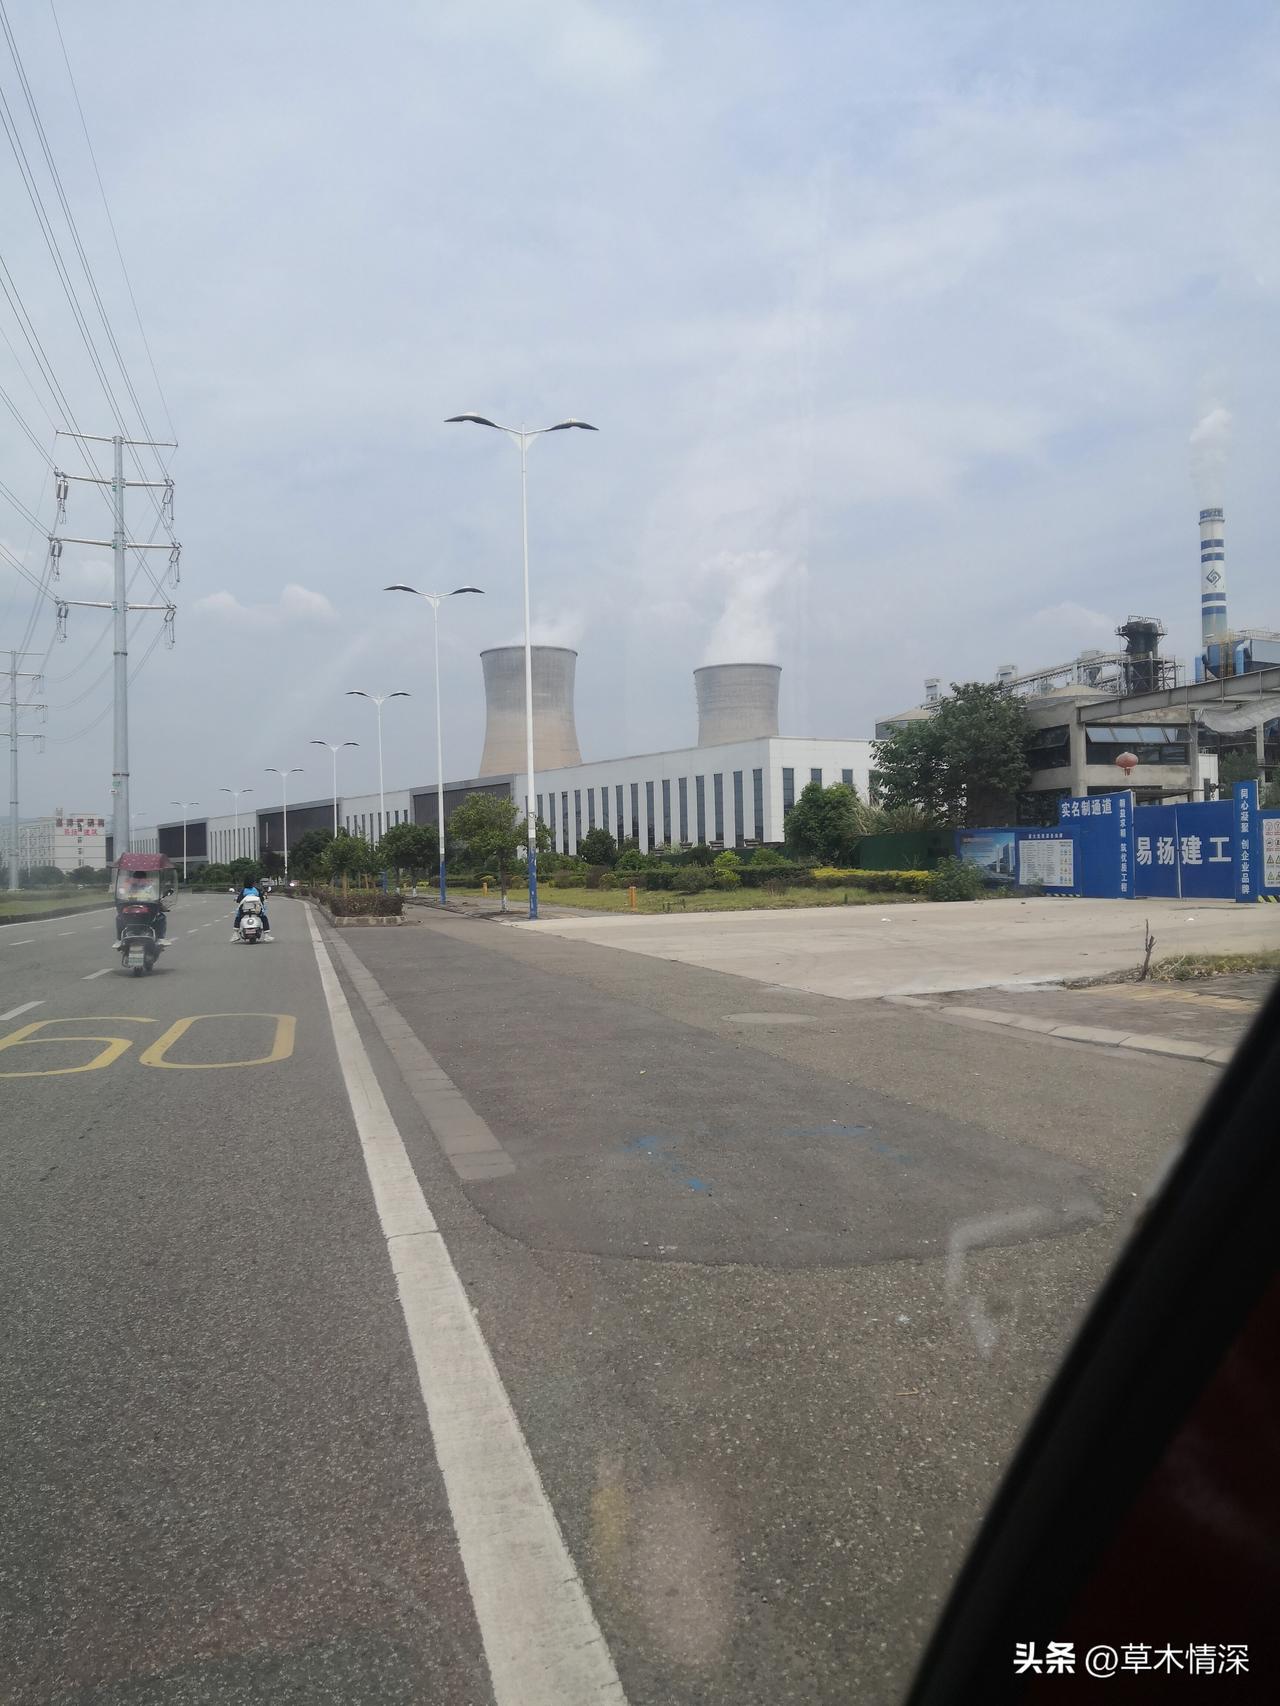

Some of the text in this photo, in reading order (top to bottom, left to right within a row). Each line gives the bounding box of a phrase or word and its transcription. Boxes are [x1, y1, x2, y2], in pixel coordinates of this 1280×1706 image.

[1061, 798, 1113, 818] 实名制通道
[1136, 835, 1232, 865] 易扬建工
[0, 1012, 297, 1078] 60
